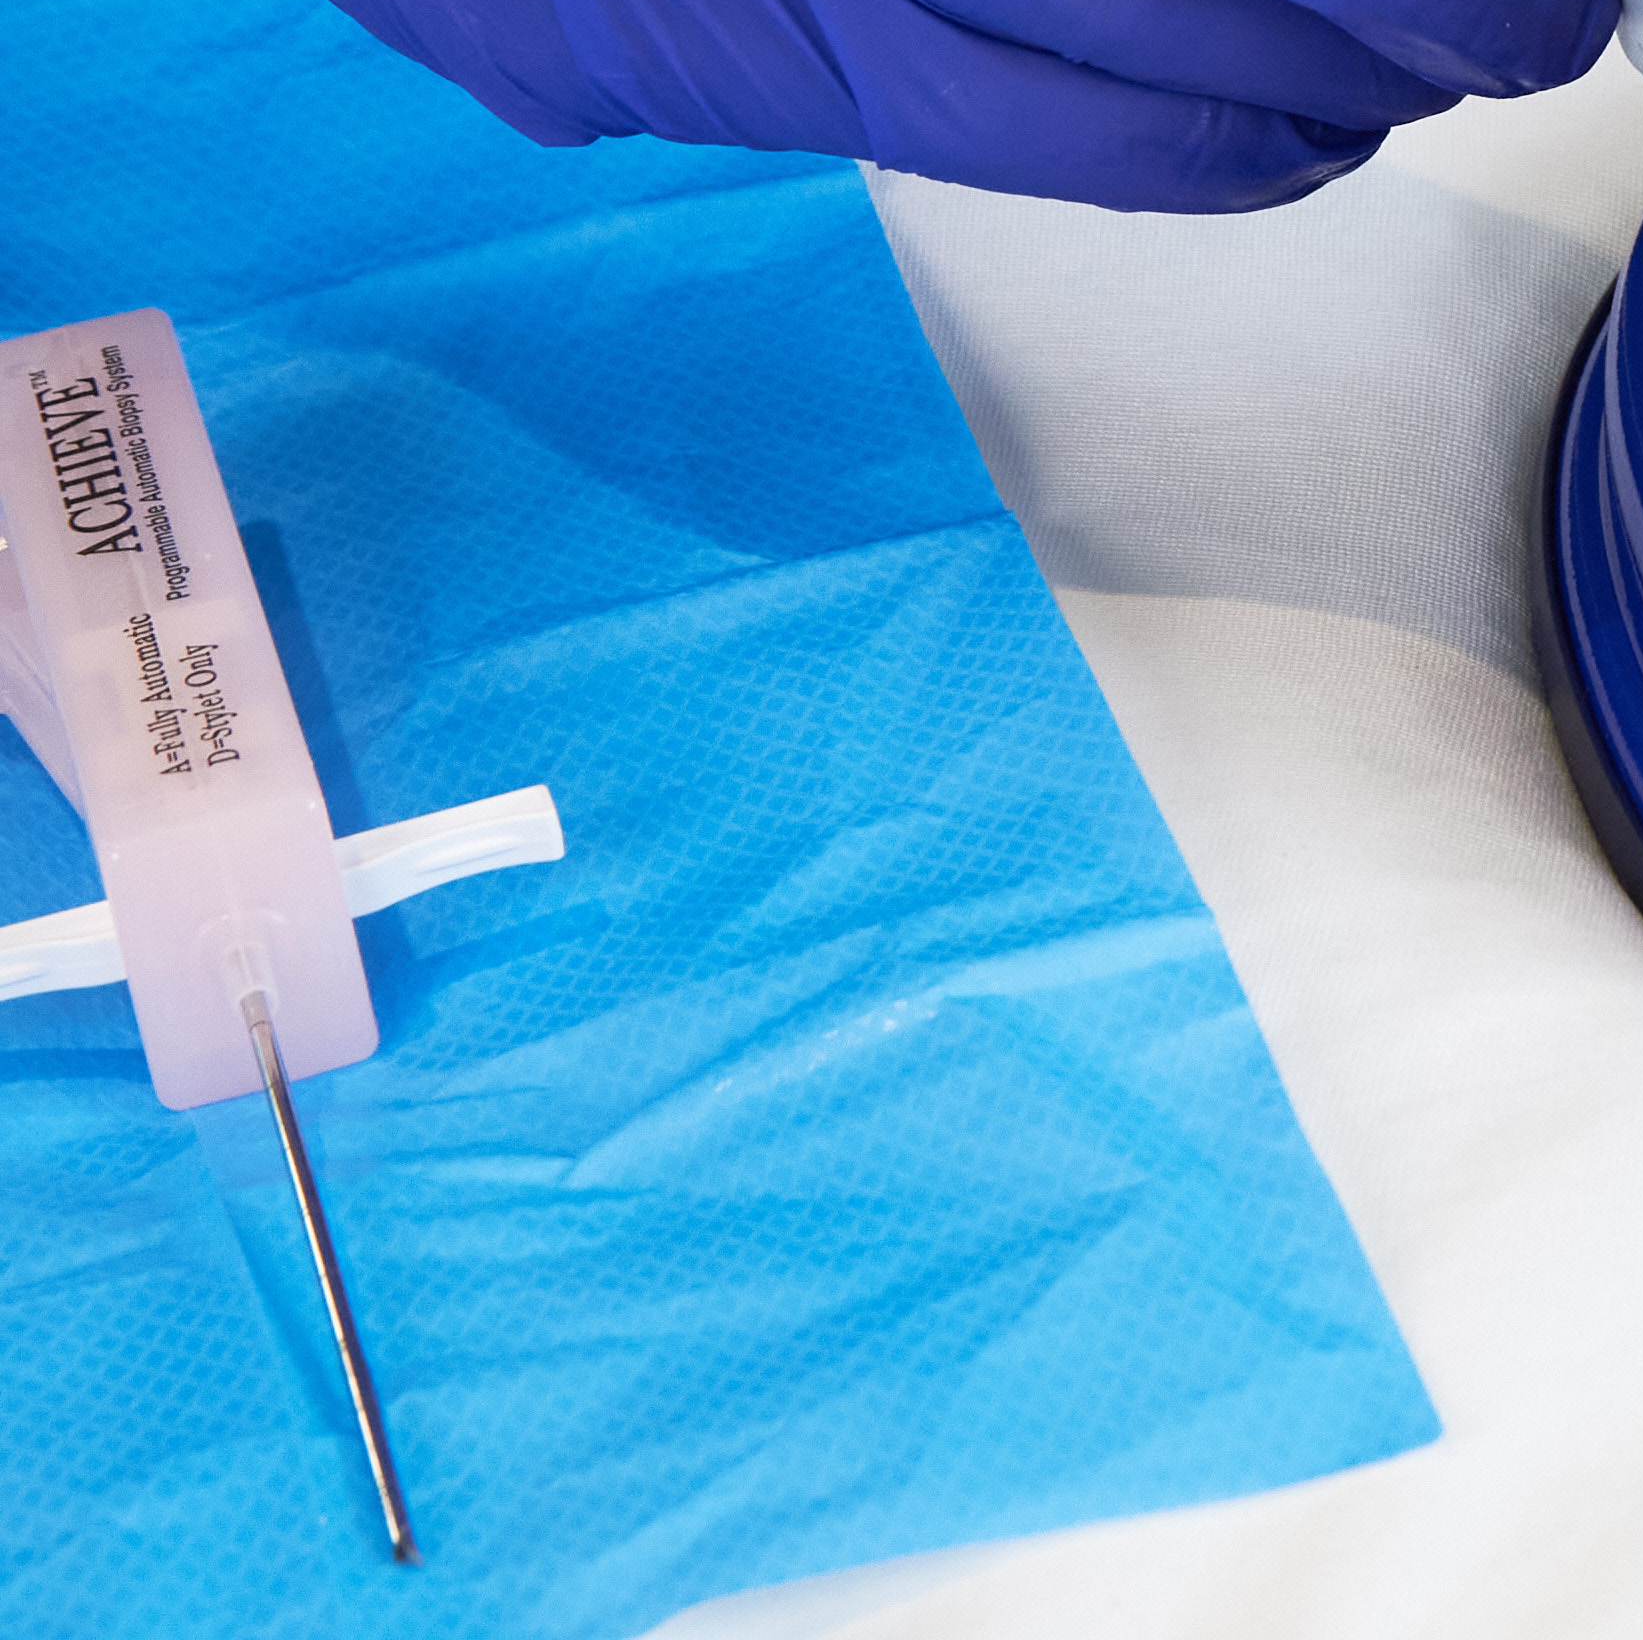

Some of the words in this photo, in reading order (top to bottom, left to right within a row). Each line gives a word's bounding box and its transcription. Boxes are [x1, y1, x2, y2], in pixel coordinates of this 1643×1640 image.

[100, 345, 134, 392] System
[115, 393, 144, 438] Biopsy
[125, 437, 163, 502] Automatic
[143, 503, 190, 601] Programmable
[123, 613, 173, 703] Automatic
[179, 644, 219, 688] Only
[147, 708, 192, 775] A=Fully
[192, 689, 241, 767] D=Stylet
